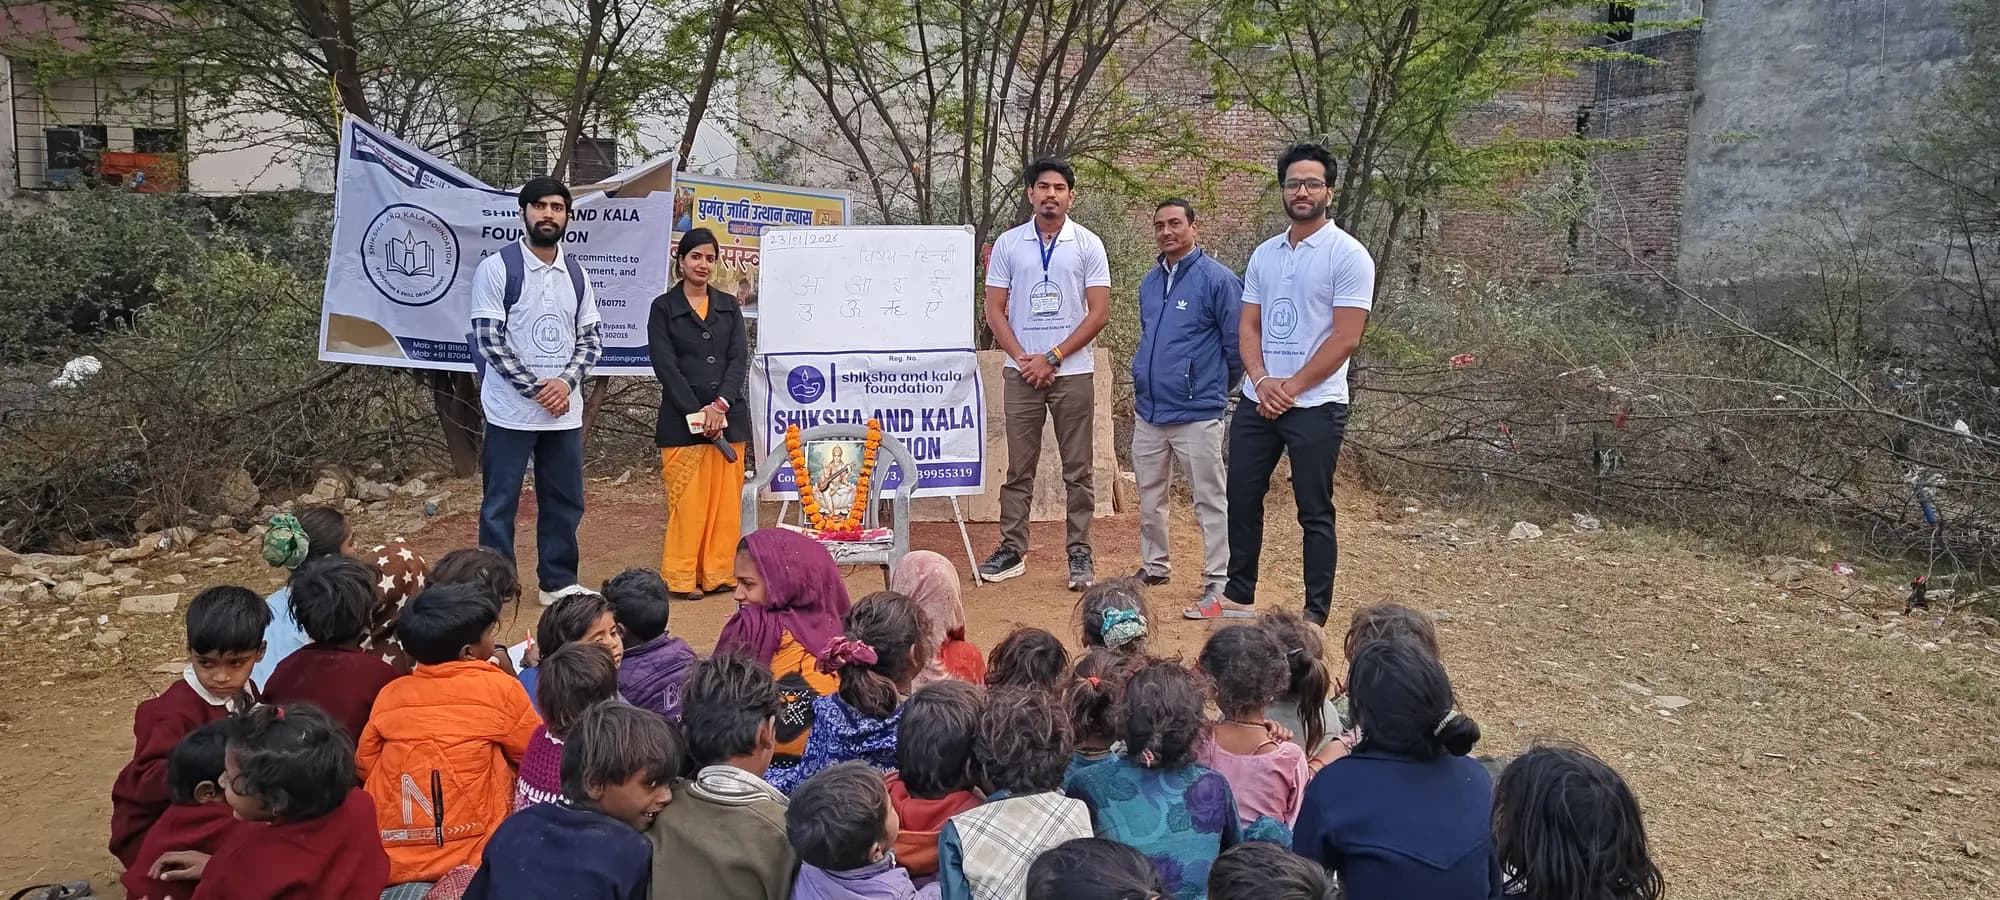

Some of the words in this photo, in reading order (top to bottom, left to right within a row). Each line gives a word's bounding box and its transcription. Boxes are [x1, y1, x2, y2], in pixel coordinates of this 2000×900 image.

[602, 208, 640, 222] KALA
[698, 197, 724, 221] घुमंतू
[726, 199, 750, 219] जाति
[751, 205, 784, 223] उत्थान
[785, 208, 814, 225] न्यास
[403, 211, 426, 222] KALA
[426, 219, 453, 265] FOUNDATION
[578, 253, 628, 263] committed
[630, 255, 640, 263] to
[619, 268, 637, 276] and
[798, 303, 815, 322] उ
[925, 300, 944, 320] ए
[841, 371, 897, 384] shiksha
[900, 371, 928, 383] and
[932, 370, 962, 382] kala
[865, 382, 944, 395] foundation
[774, 409, 863, 435] SHIKSHA
[873, 408, 914, 433] AND
[921, 405, 975, 432] KALA
